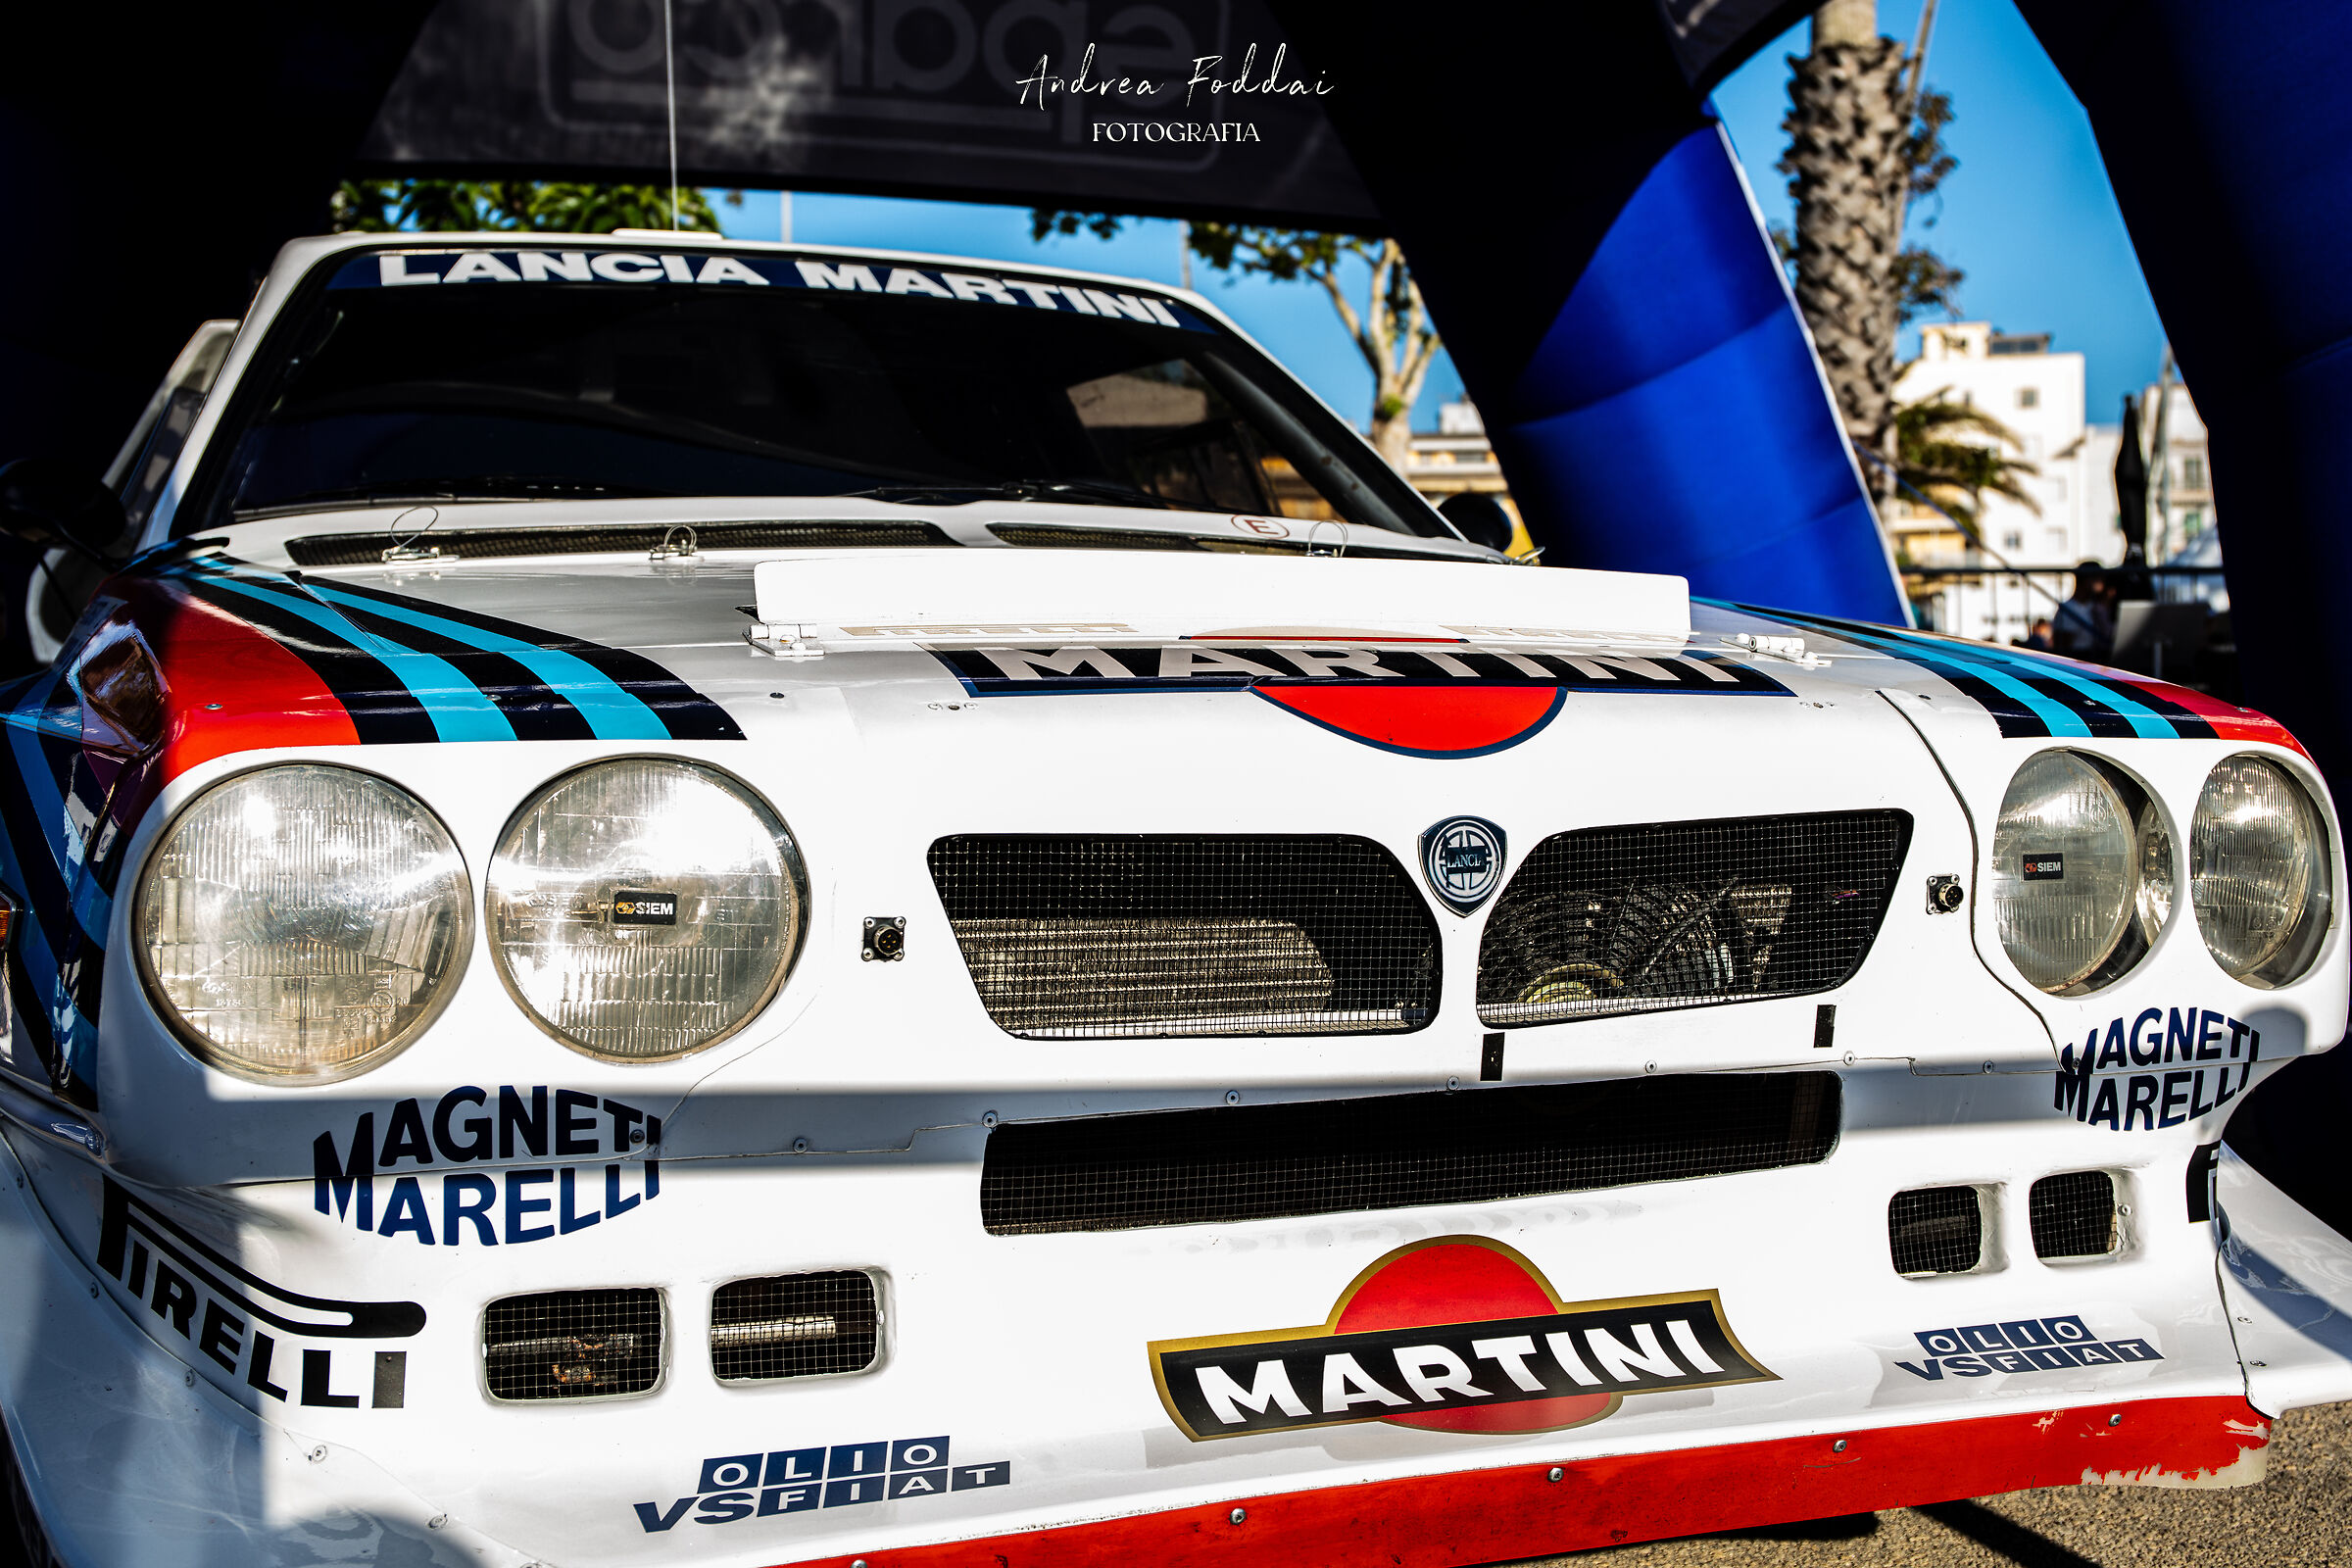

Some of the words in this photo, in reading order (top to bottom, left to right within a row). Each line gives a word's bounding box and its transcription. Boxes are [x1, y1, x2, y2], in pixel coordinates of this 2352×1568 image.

[379, 251, 770, 286] LANCIA
[795, 260, 1181, 328] MARTINI
[975, 644, 1740, 682] MARTINI
[2036, 861, 2062, 872] SIEM
[635, 901, 673, 915] SIEM
[2060, 1006, 2261, 1075] MAGNETI
[313, 1085, 662, 1177] MAGNETI
[2053, 1062, 2251, 1132] MARELLI
[313, 1160, 660, 1247] MARELLI
[96, 1174, 427, 1410] PIRELLI
[1927, 1320, 2084, 1353] OLIO
[1195, 1318, 1726, 1426] MARTINI
[711, 1444, 938, 1488] OLIO
